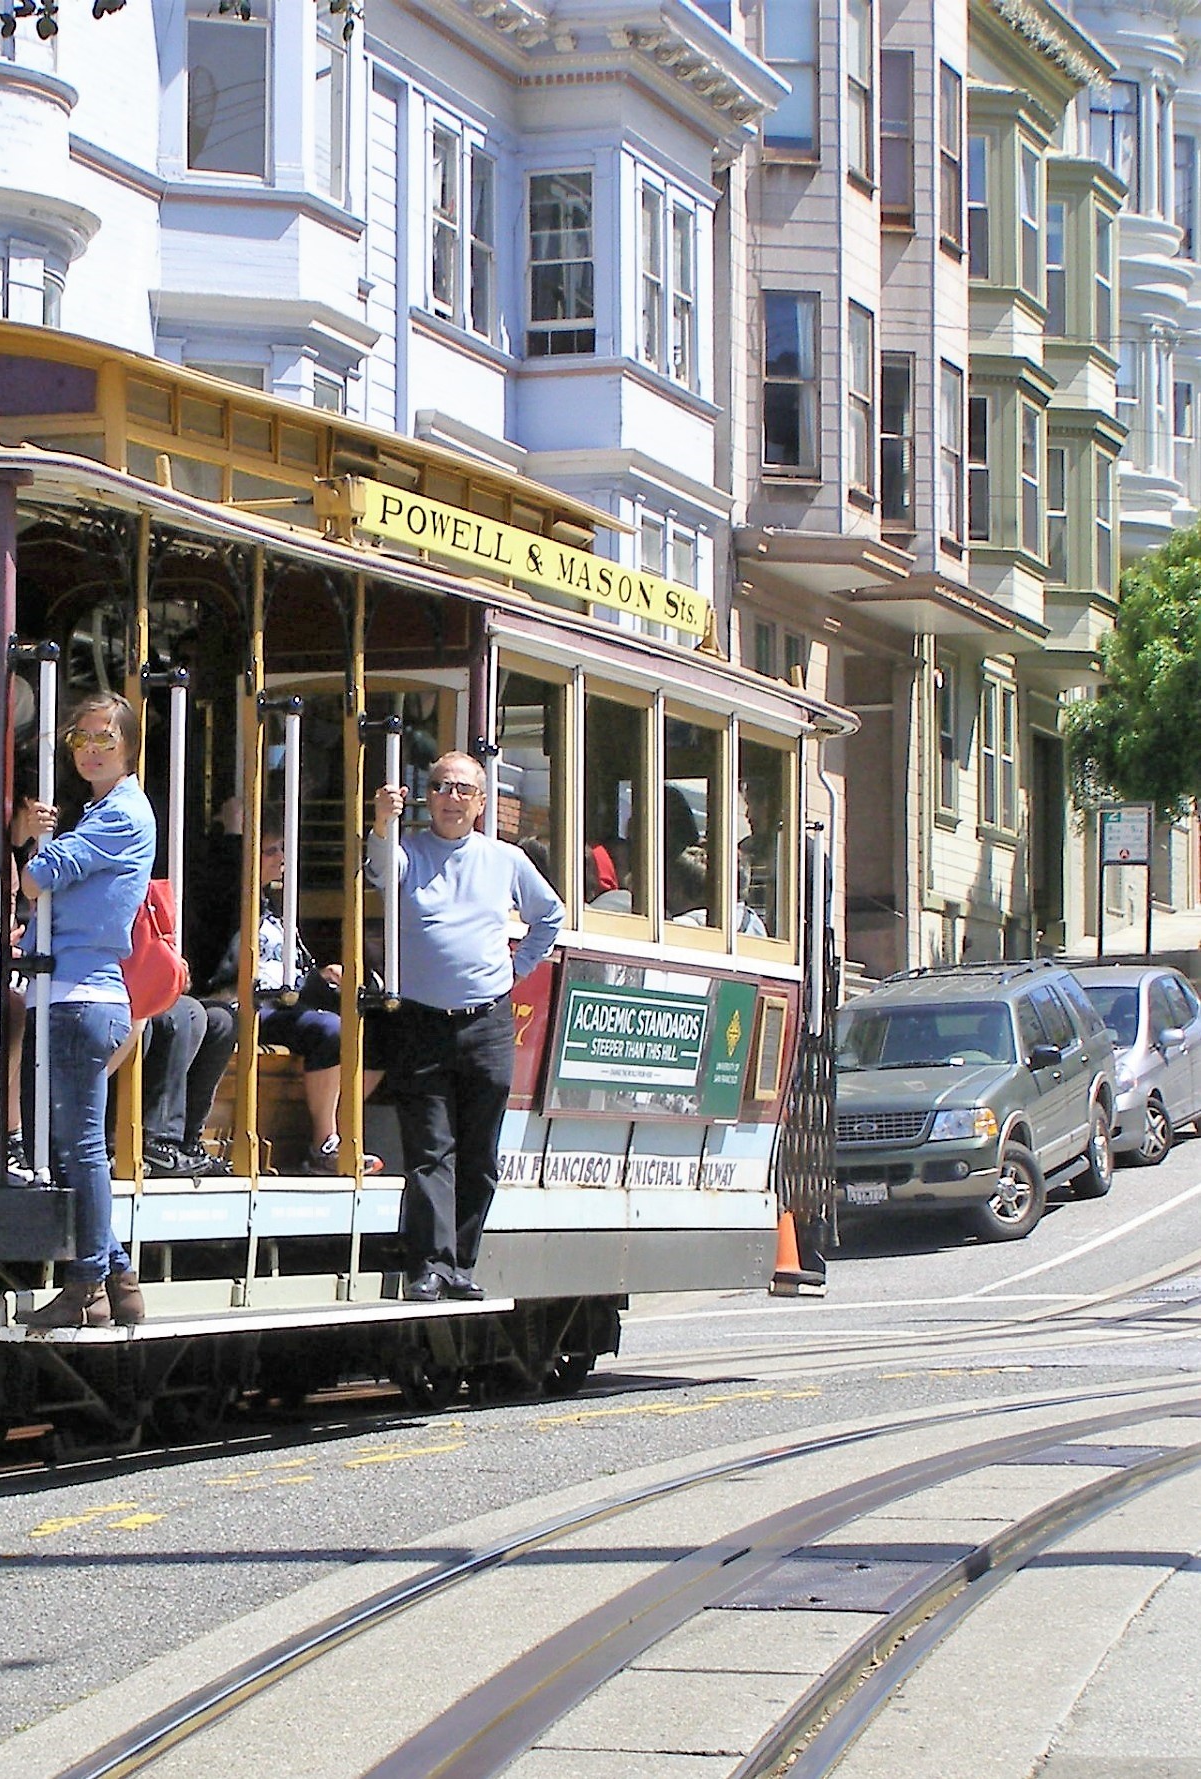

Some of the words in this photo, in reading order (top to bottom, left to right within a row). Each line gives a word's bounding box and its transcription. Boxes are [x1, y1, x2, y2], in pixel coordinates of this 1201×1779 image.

[379, 494, 512, 565] POWELL
[526, 543, 544, 576] &
[557, 553, 654, 609] MASON
[664, 590, 697, 625] Sts.
[574, 1003, 636, 1035] ACADEMIC
[636, 1009, 700, 1041] STANDARDS
[591, 1037, 625, 1057] STEEPER
[624, 1040, 646, 1059] THAN
[646, 1042, 663, 1060] THIS
[497, 1155, 527, 1181] SAN
